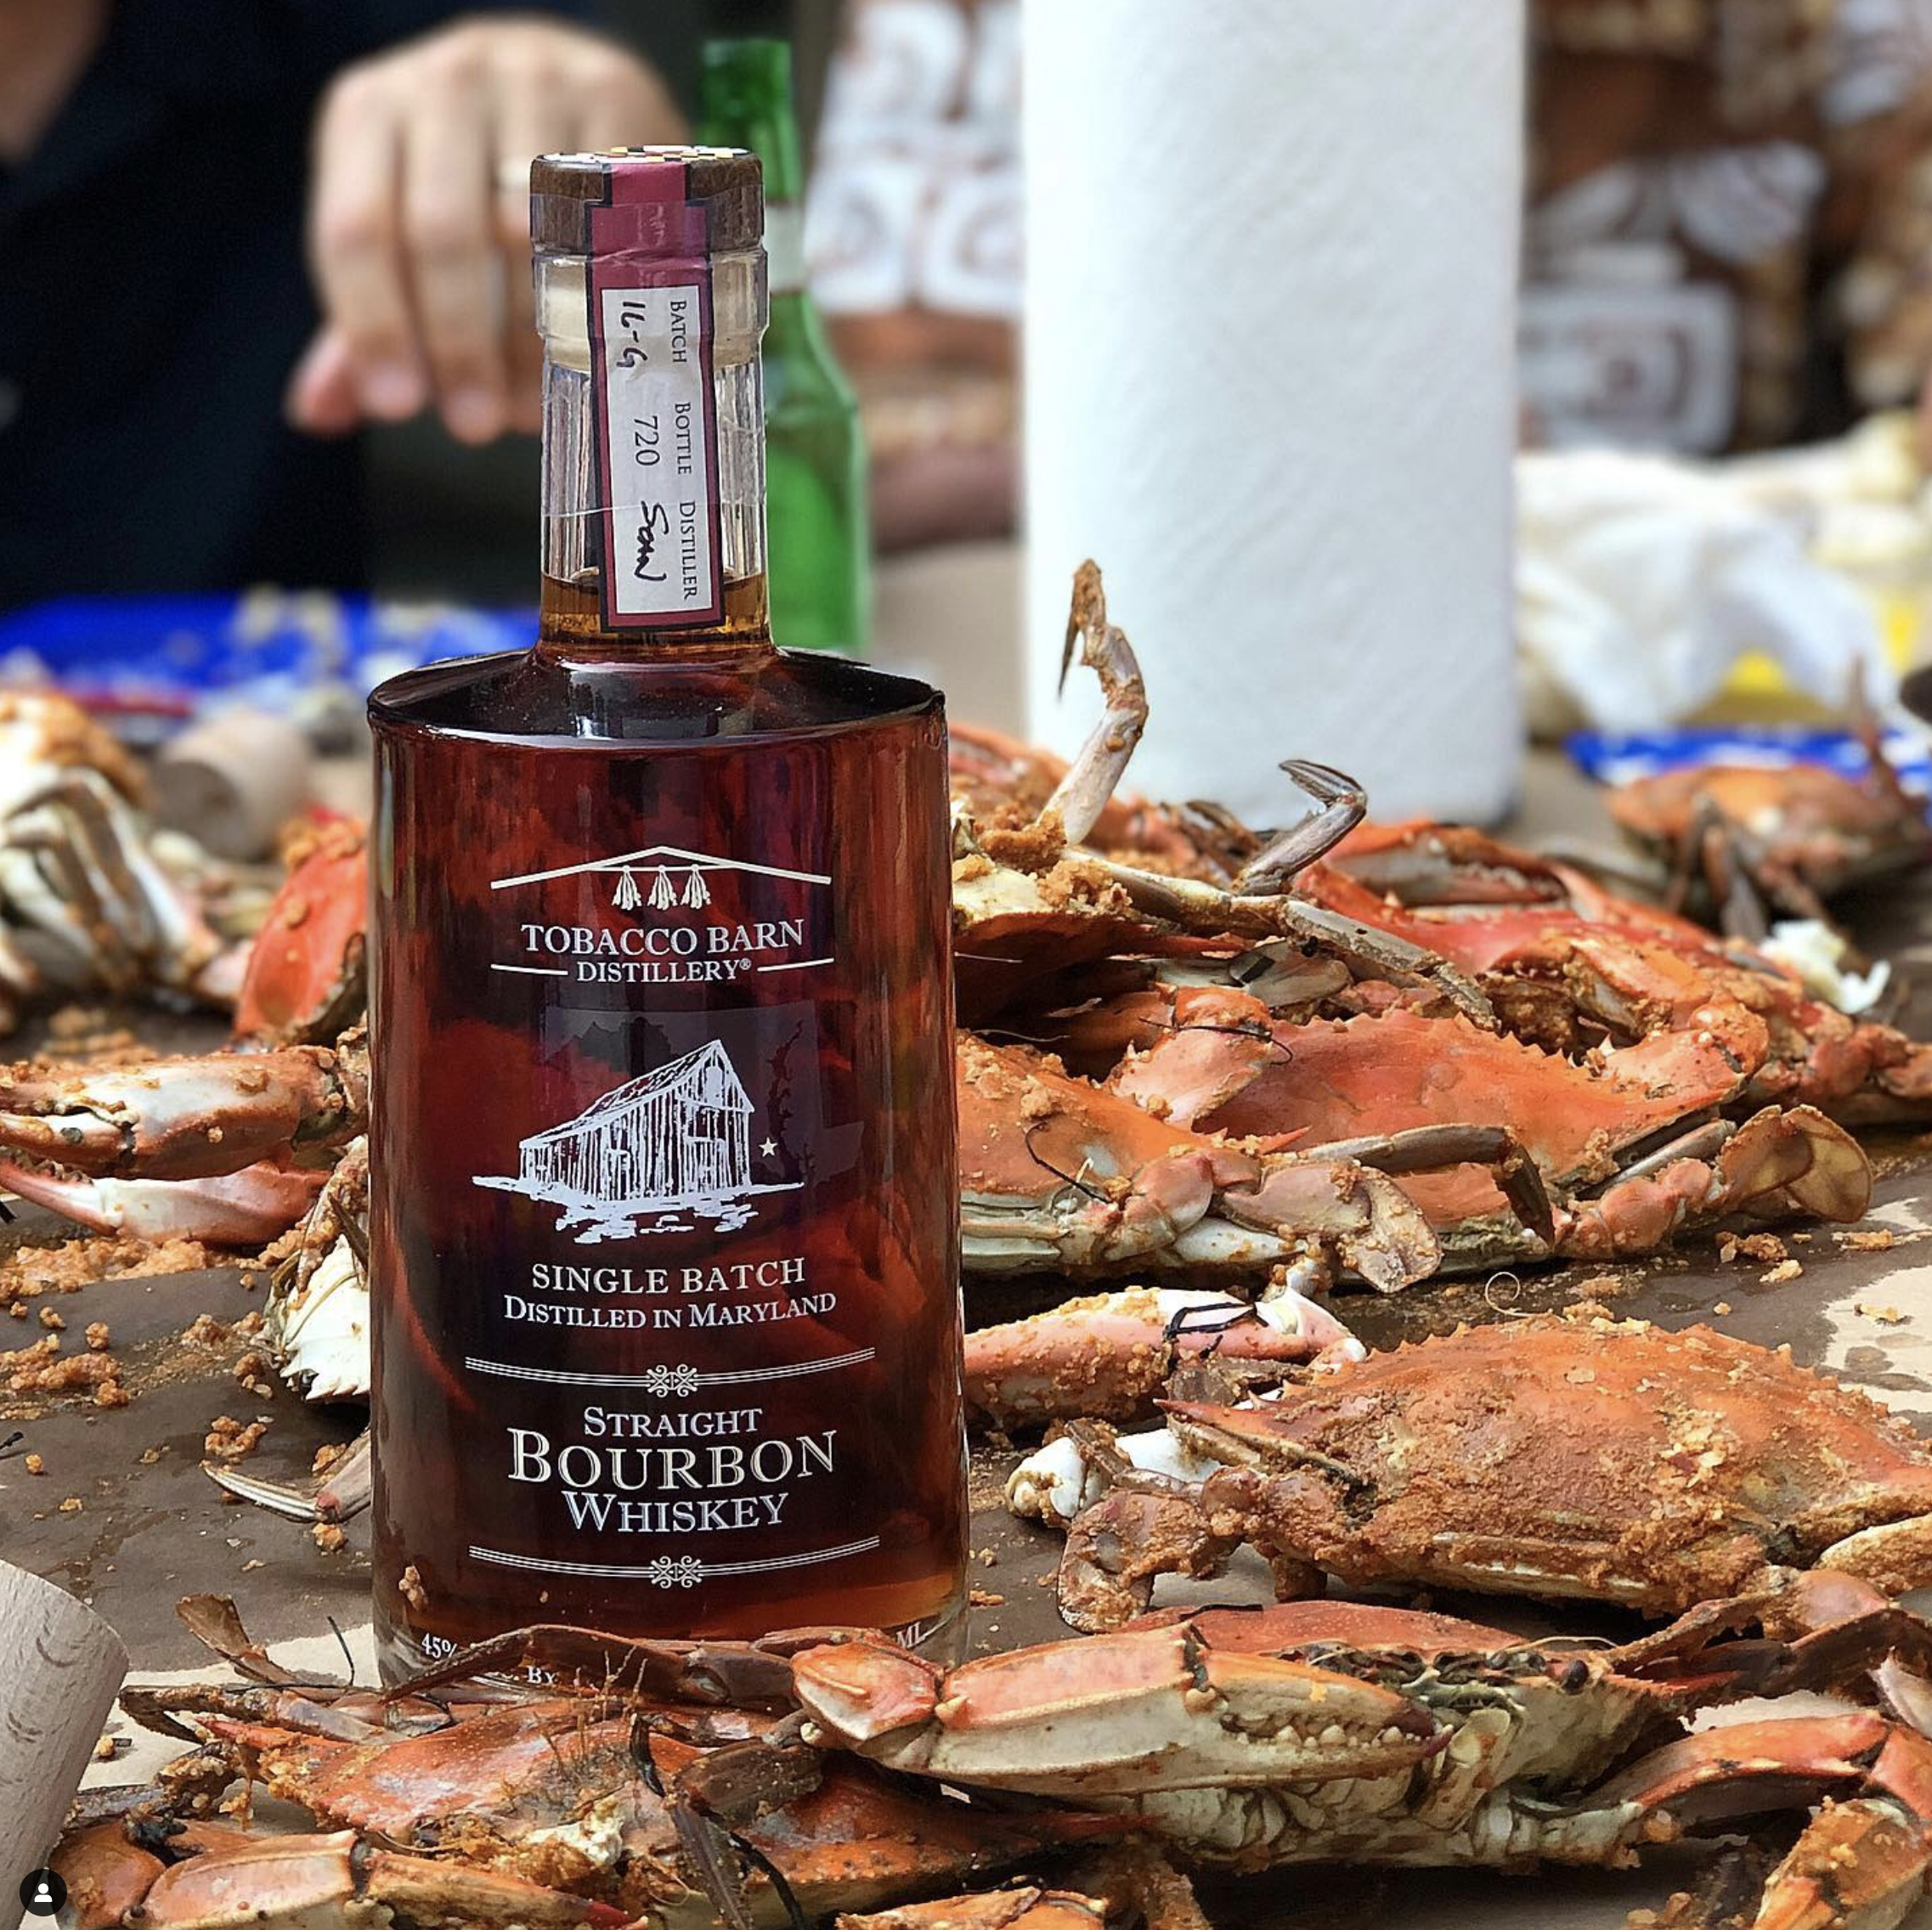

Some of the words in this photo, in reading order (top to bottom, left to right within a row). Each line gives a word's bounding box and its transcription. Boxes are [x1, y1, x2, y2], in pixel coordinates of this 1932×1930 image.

[669, 300, 687, 364] BATCH
[633, 415, 660, 467] 720
[674, 403, 692, 476] BOTTLE
[679, 501, 698, 600] DISTILLER
[520, 924, 698, 957] TOBACCO
[707, 919, 804, 955] BARN
[532, 1263, 669, 1294] SINGLE
[680, 1257, 805, 1293] BATCH
[504, 1295, 647, 1329] DISTILLED
[652, 1309, 681, 1328] IN
[688, 1292, 837, 1327] MARYLAND
[584, 1407, 762, 1437] STRAIGHT
[506, 1427, 838, 1491] BOURBON
[561, 1490, 789, 1532] WHISKEY
